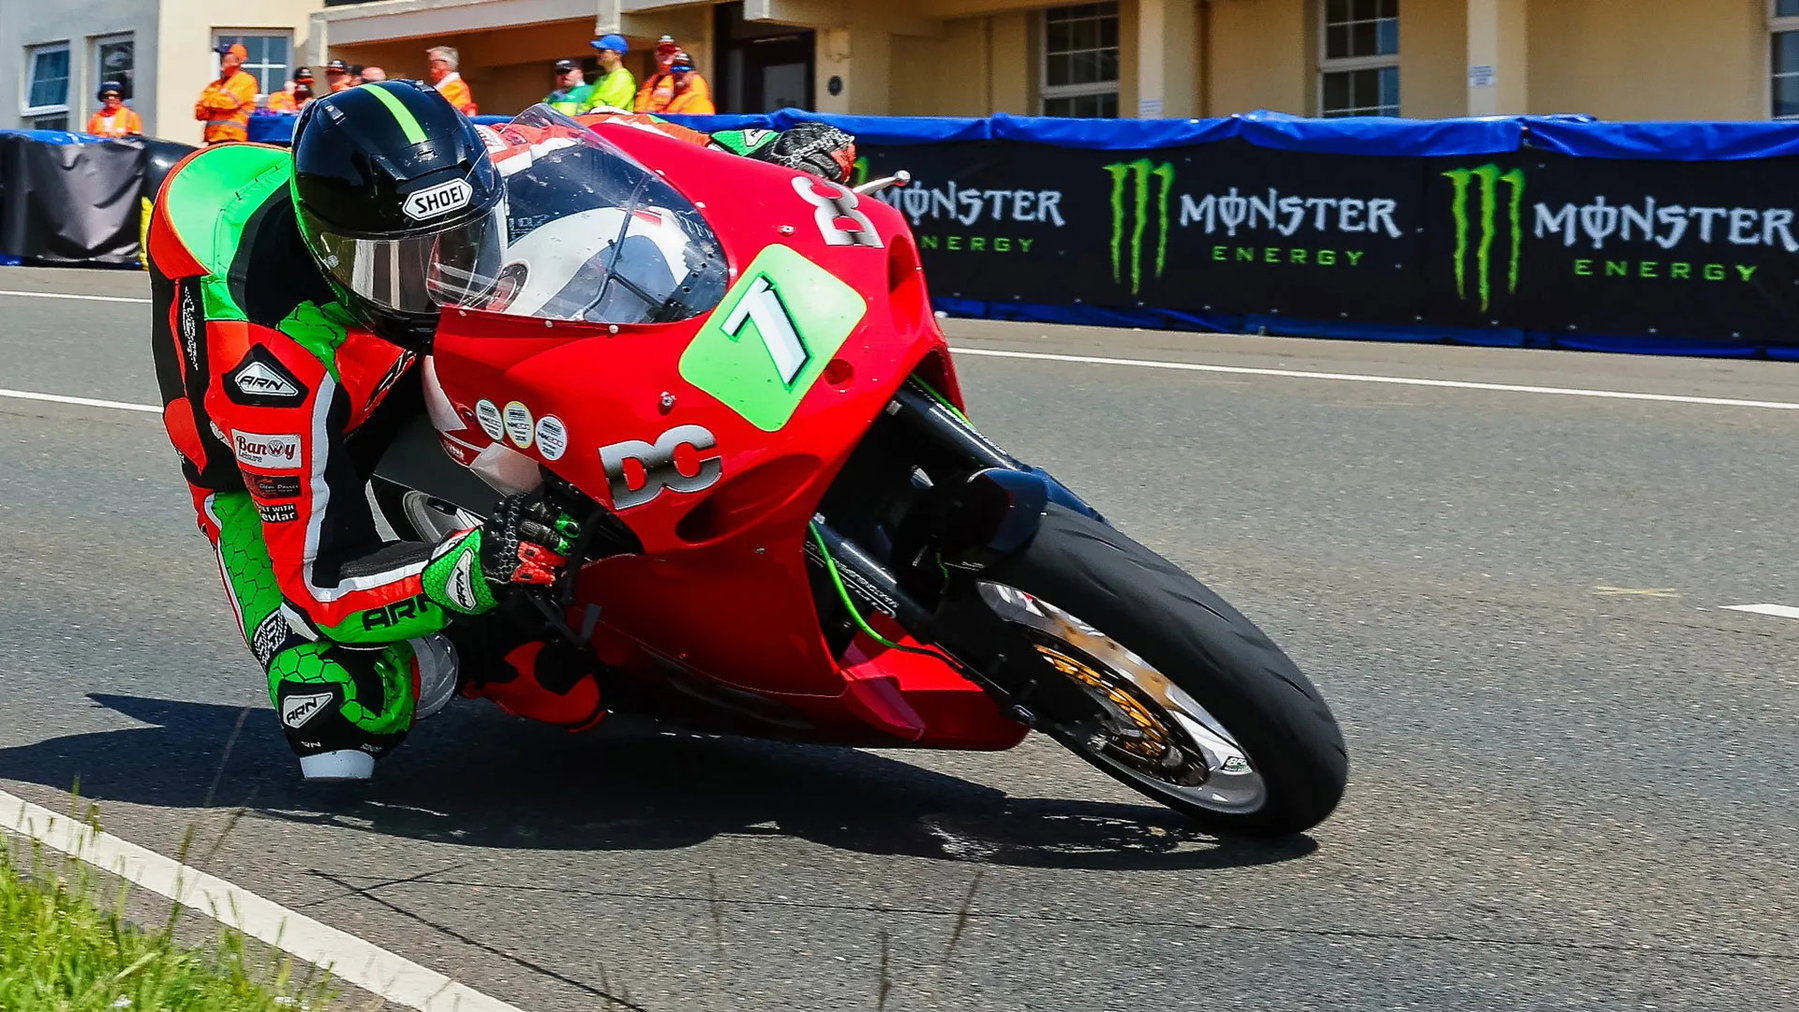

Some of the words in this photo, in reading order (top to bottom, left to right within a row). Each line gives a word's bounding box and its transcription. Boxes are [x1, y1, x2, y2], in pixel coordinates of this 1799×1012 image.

[414, 185, 465, 214] SHOEI
[791, 176, 885, 249] DC
[875, 181, 1066, 227] MONSTER
[1179, 187, 1403, 239] MONSTER
[1533, 195, 1799, 253] MONSTER
[921, 235, 1034, 252] NERGY
[1211, 245, 1364, 266] ENERGY
[1574, 259, 1757, 282] ENERGY
[720, 273, 813, 391] 7
[239, 376, 285, 391] ARN
[598, 424, 722, 510] DC
[261, 512, 295, 521] evlar
[286, 697, 318, 724] ARN
